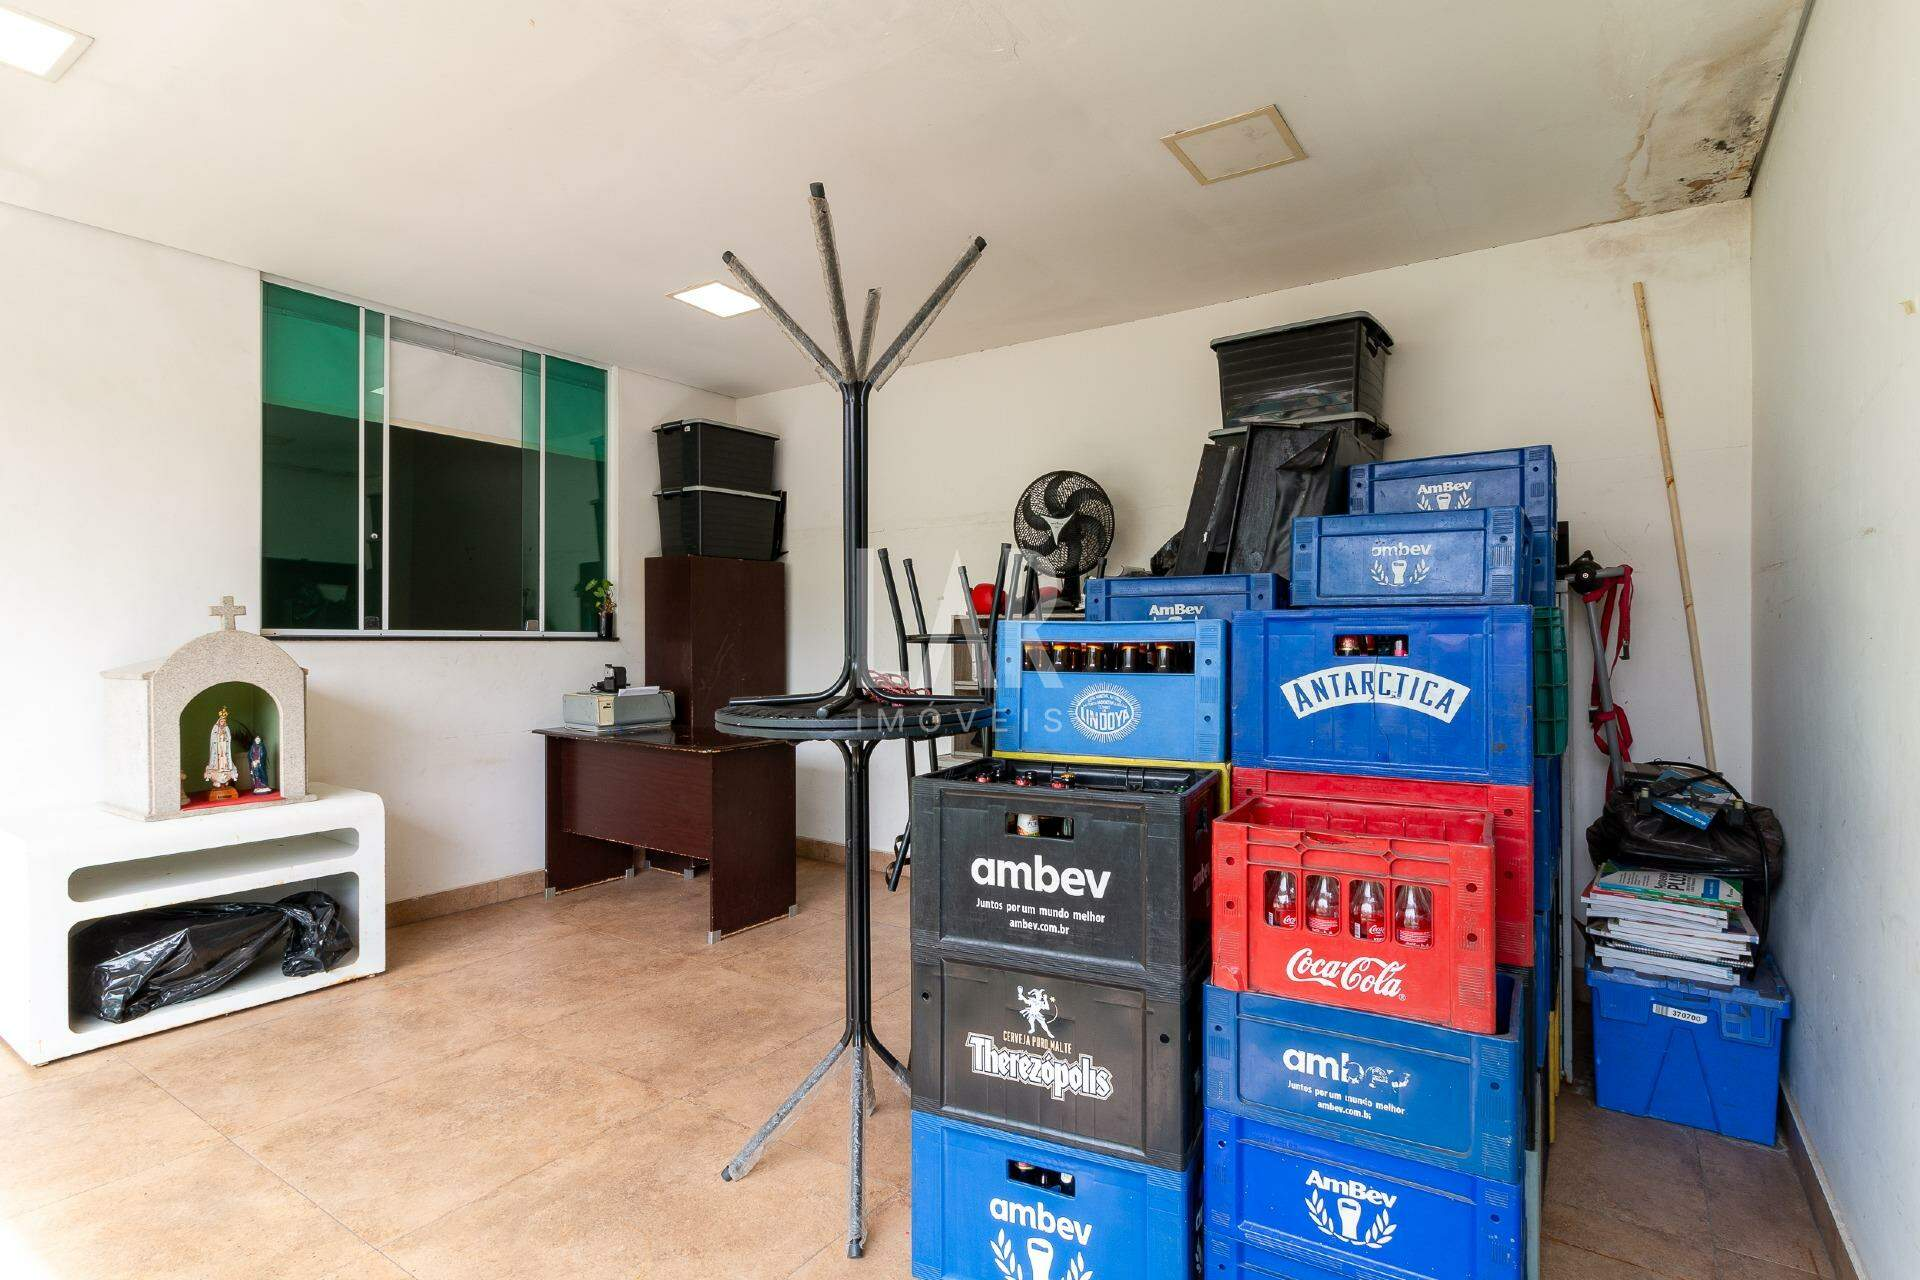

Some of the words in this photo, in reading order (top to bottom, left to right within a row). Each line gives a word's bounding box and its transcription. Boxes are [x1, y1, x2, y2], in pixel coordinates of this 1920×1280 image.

[1417, 481, 1472, 495] AmBev
[1371, 542, 1432, 557] ambev
[1149, 604, 1203, 616] AmBev
[1293, 670, 1456, 714] ANTARCTICA
[971, 855, 1111, 898] ambev
[976, 898, 1003, 910] Juntos
[1006, 902, 1020, 913] por
[1021, 904, 1036, 915] um
[1039, 906, 1070, 919] mundo
[1072, 910, 1105, 923] melhor
[1009, 919, 1070, 935] ambev.com.br
[1286, 947, 1407, 998] Coca-Cola
[1003, 1030, 1031, 1046] CERVEJA
[1032, 1035, 1049, 1049] PURO
[1050, 1039, 1072, 1054] MALTE
[966, 1032, 1113, 1101] Therezópolis
[1288, 1080, 1313, 1094] Juntos
[1314, 1087, 1328, 1098] por
[1328, 1090, 1342, 1101] um
[1375, 1101, 1406, 1115] melhor
[1305, 1169, 1397, 1208] AmBev
[989, 1198, 1093, 1246] ambev
